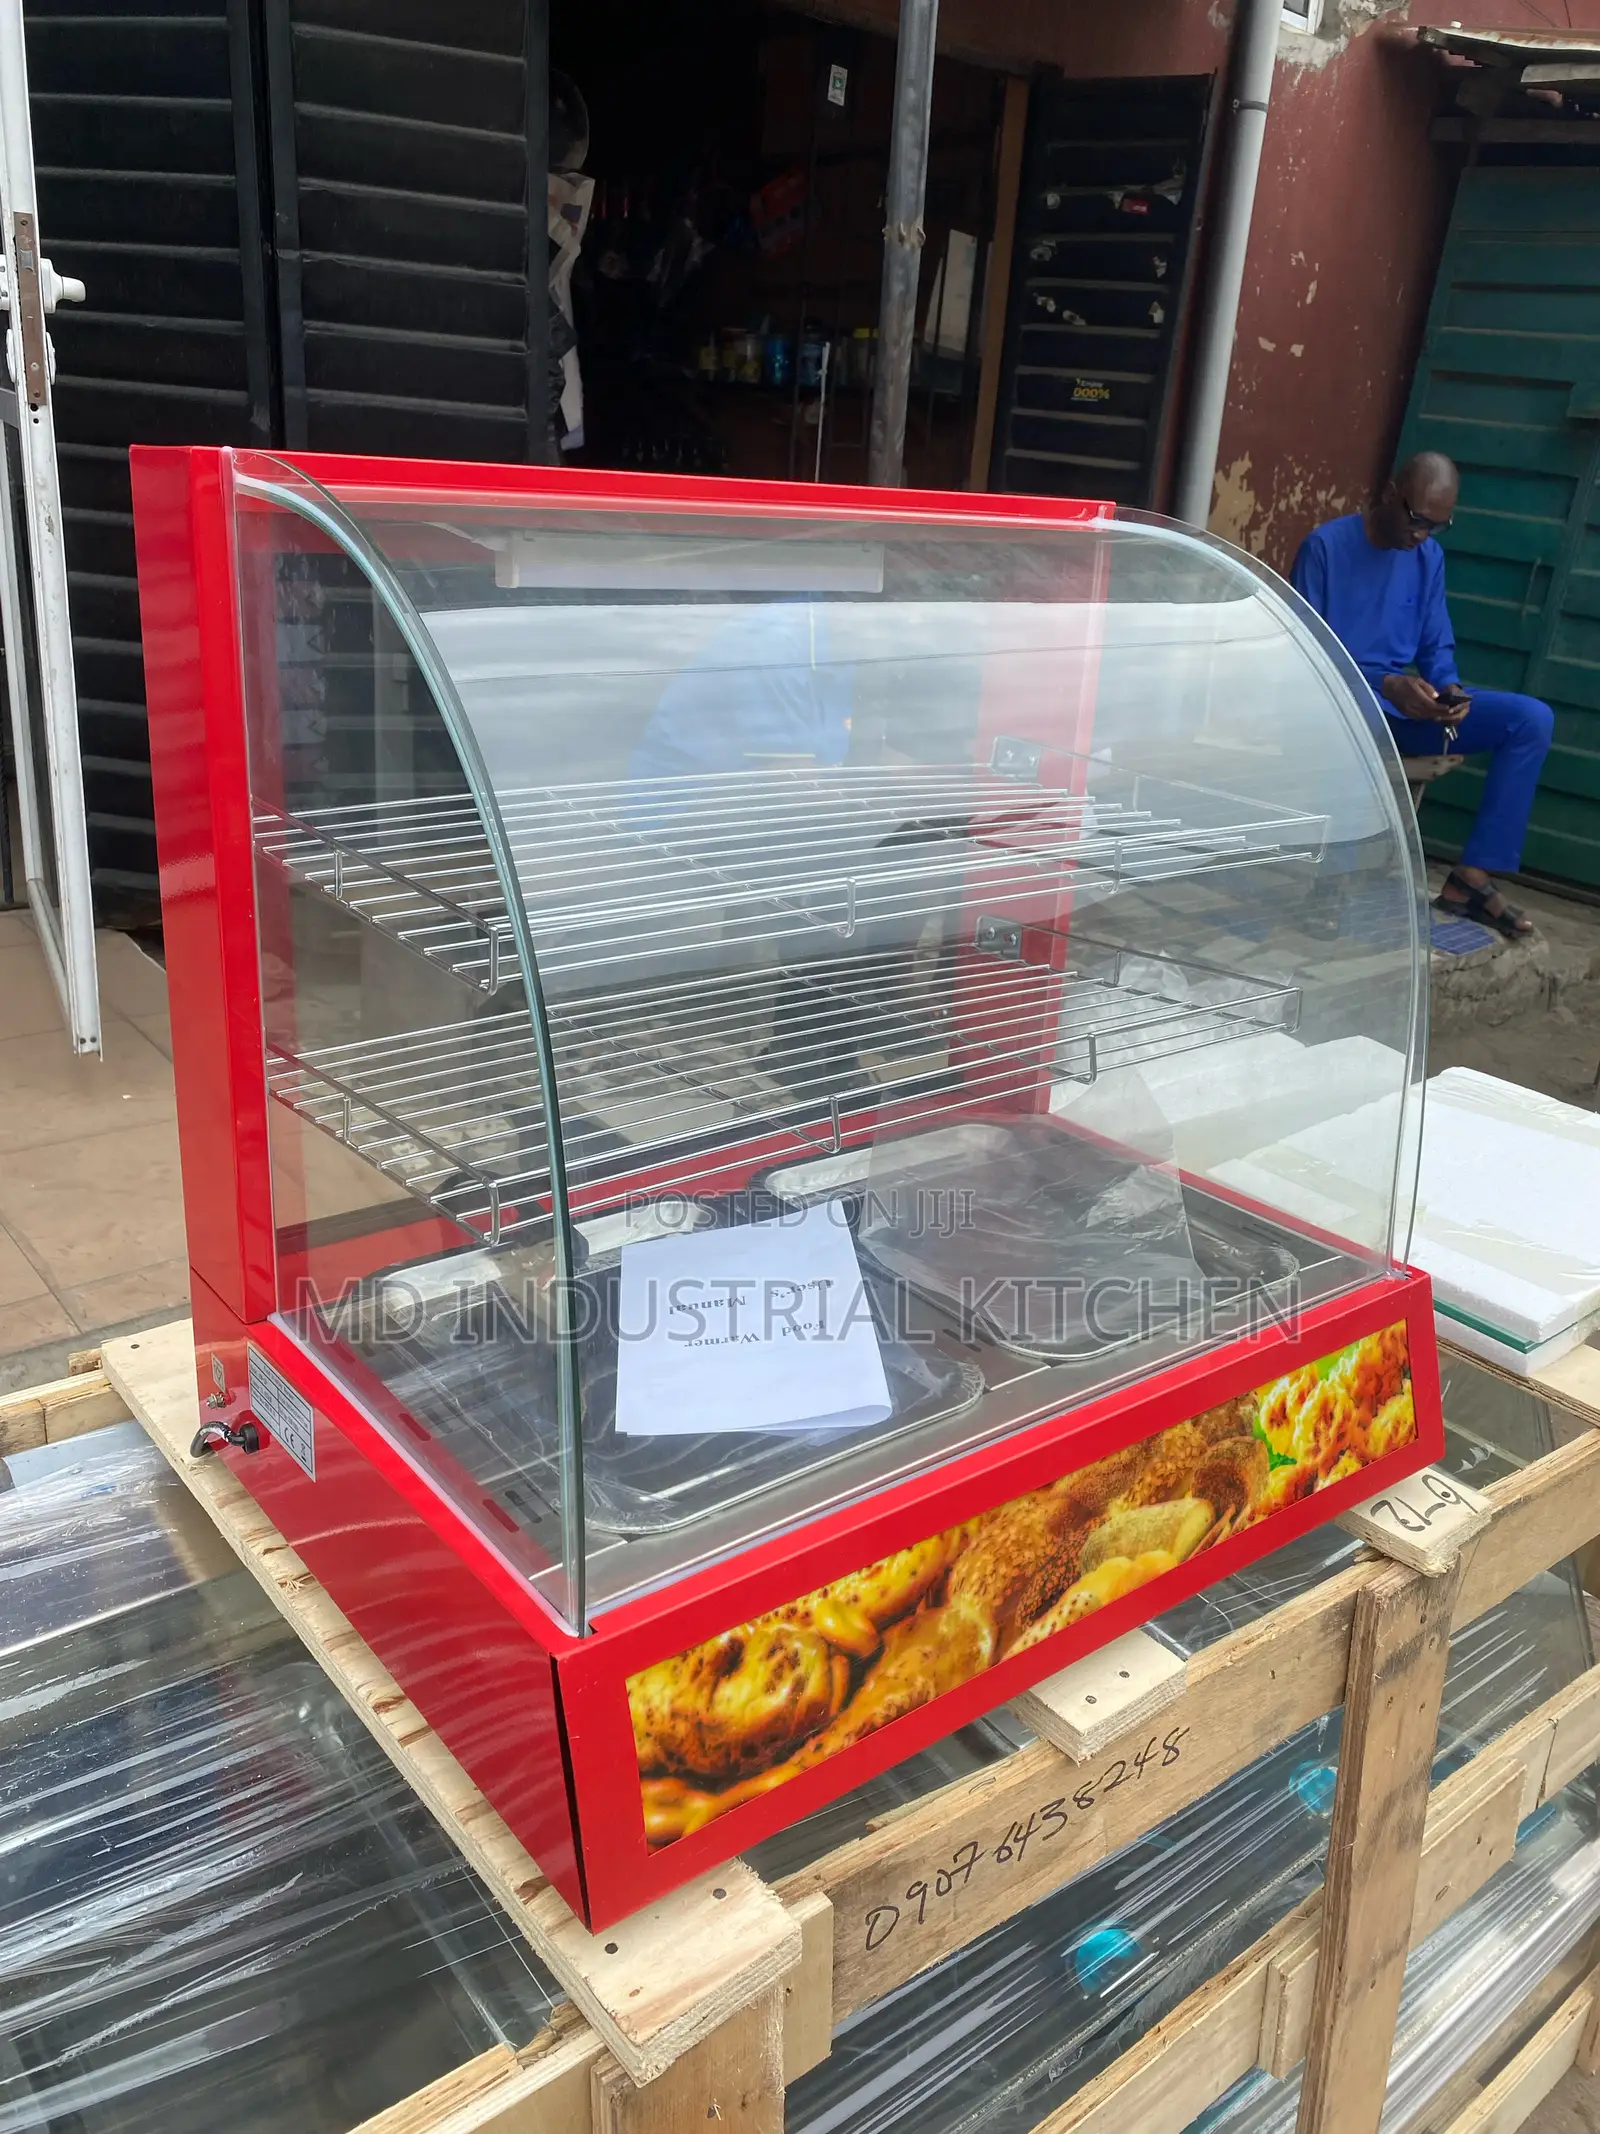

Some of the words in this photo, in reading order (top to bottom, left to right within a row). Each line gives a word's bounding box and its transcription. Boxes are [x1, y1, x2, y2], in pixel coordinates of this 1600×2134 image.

[668, 1295, 747, 1315] Manual
[781, 1320, 826, 1337] Food
[683, 1332, 761, 1348] Warmer
